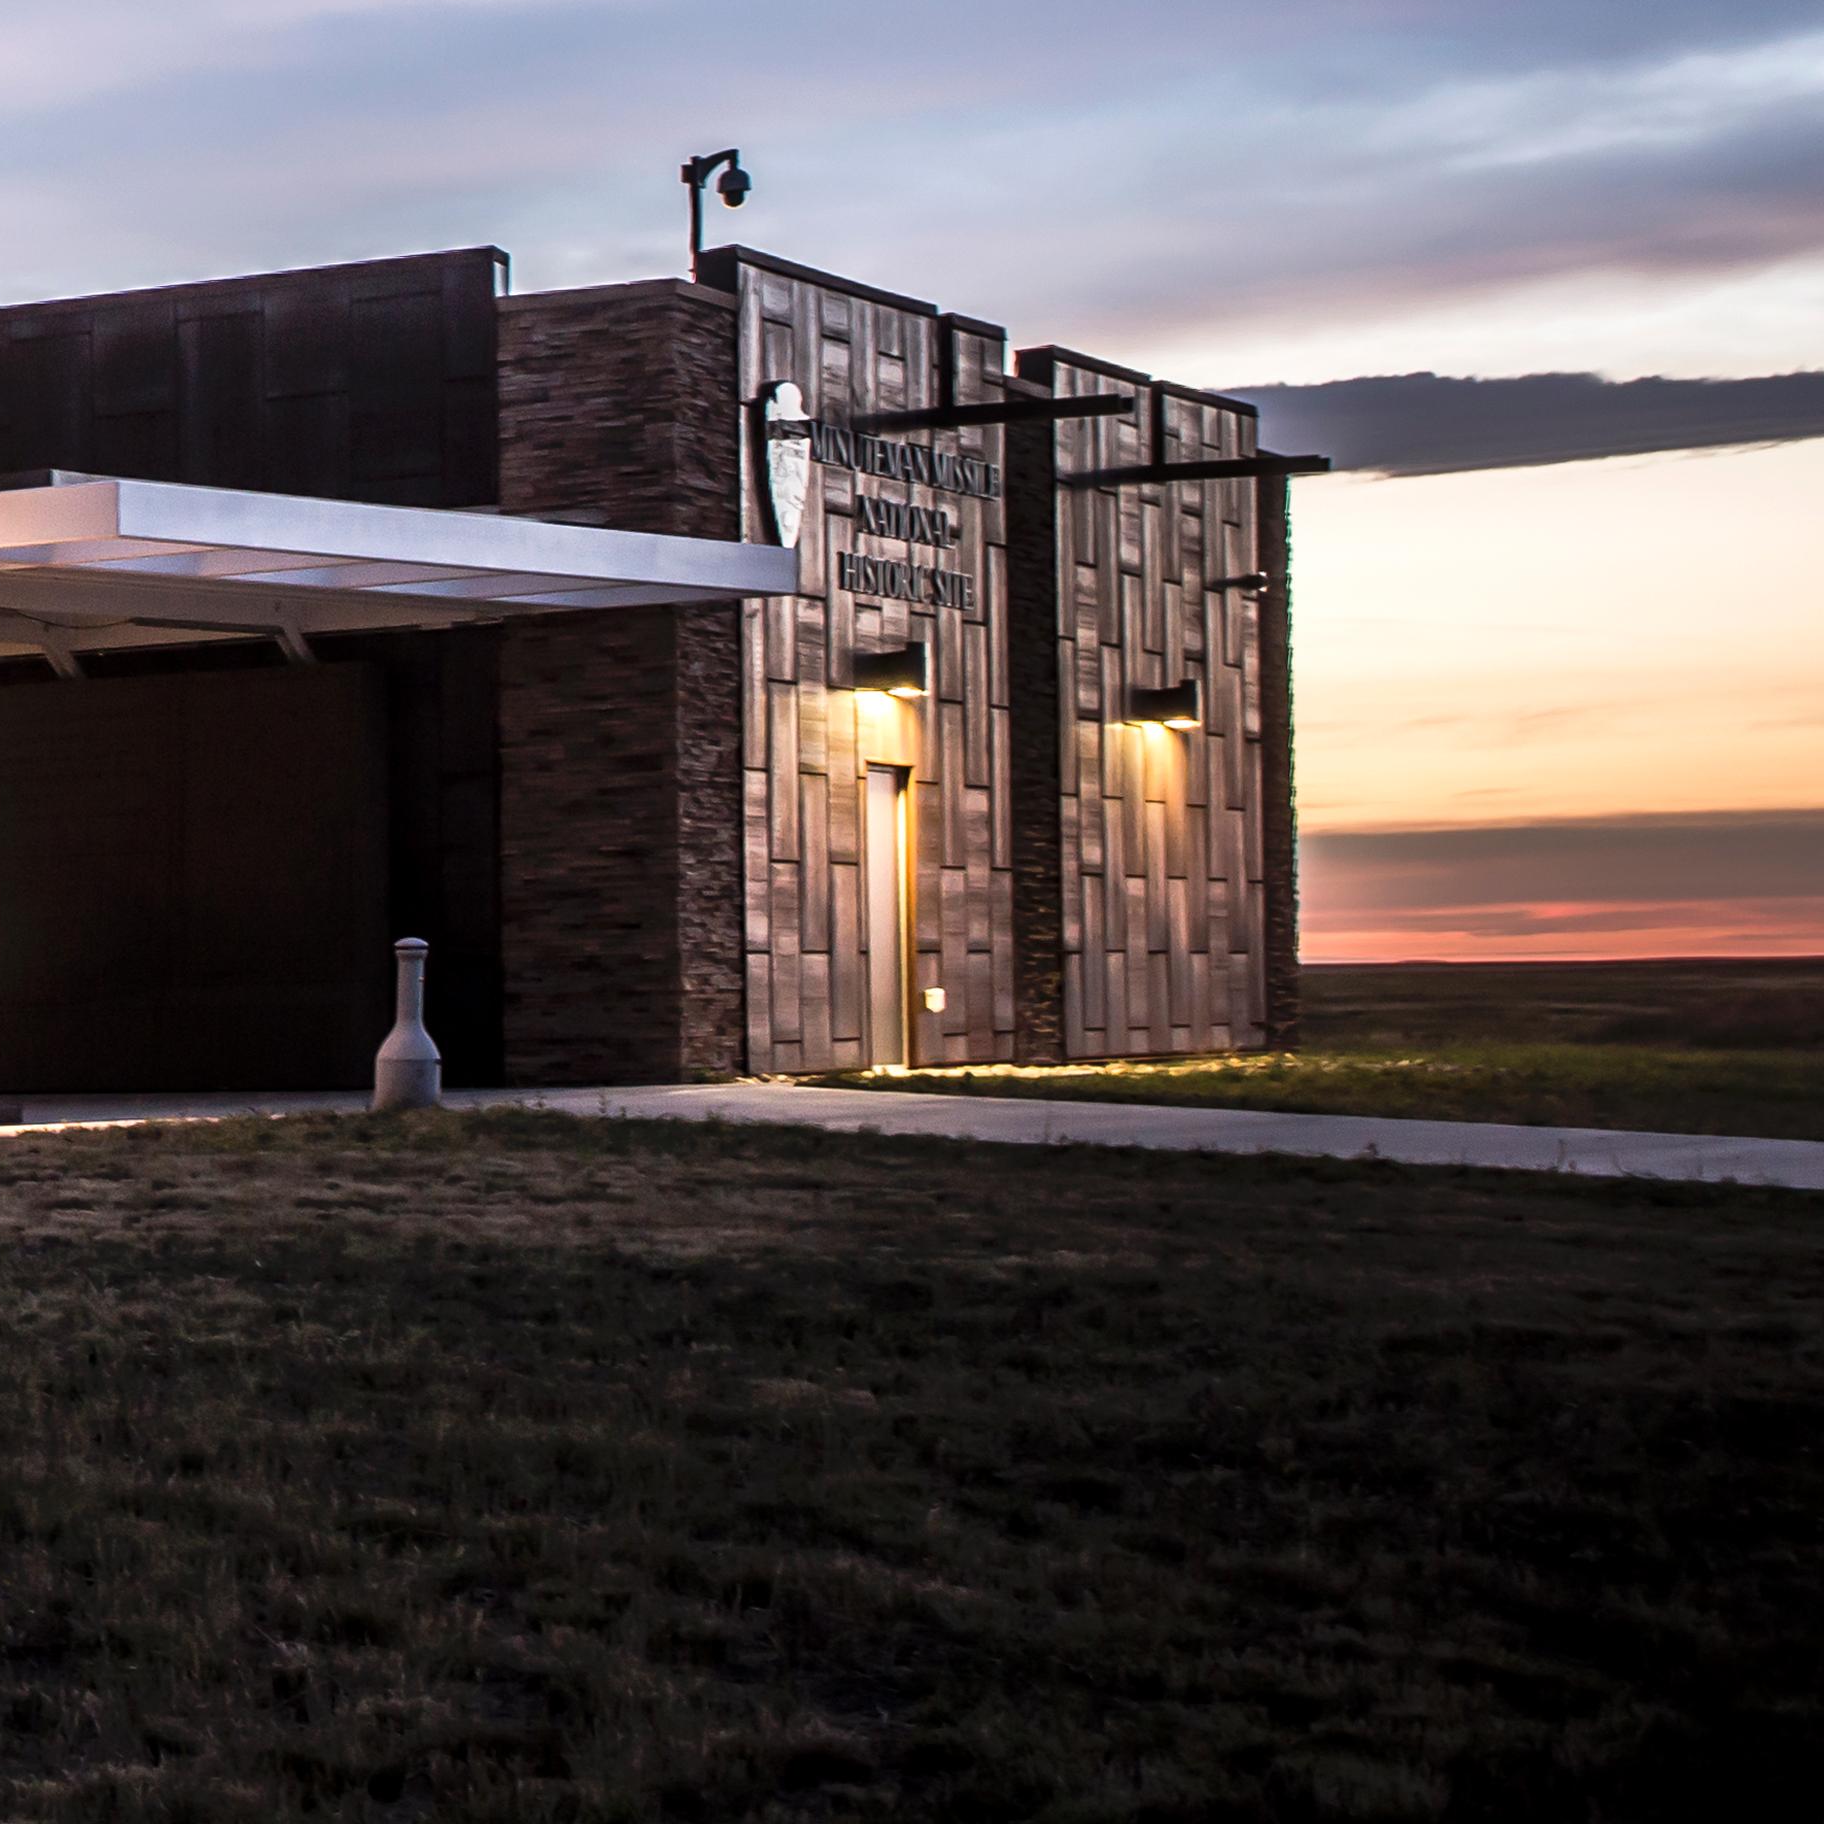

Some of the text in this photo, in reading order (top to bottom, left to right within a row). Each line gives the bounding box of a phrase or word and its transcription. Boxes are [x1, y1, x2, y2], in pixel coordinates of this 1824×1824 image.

[809, 421, 1000, 500] MINUTEMAN MISSILE
[858, 495, 955, 549] NATIONAL
[839, 552, 974, 610] HISTORIC SITE
